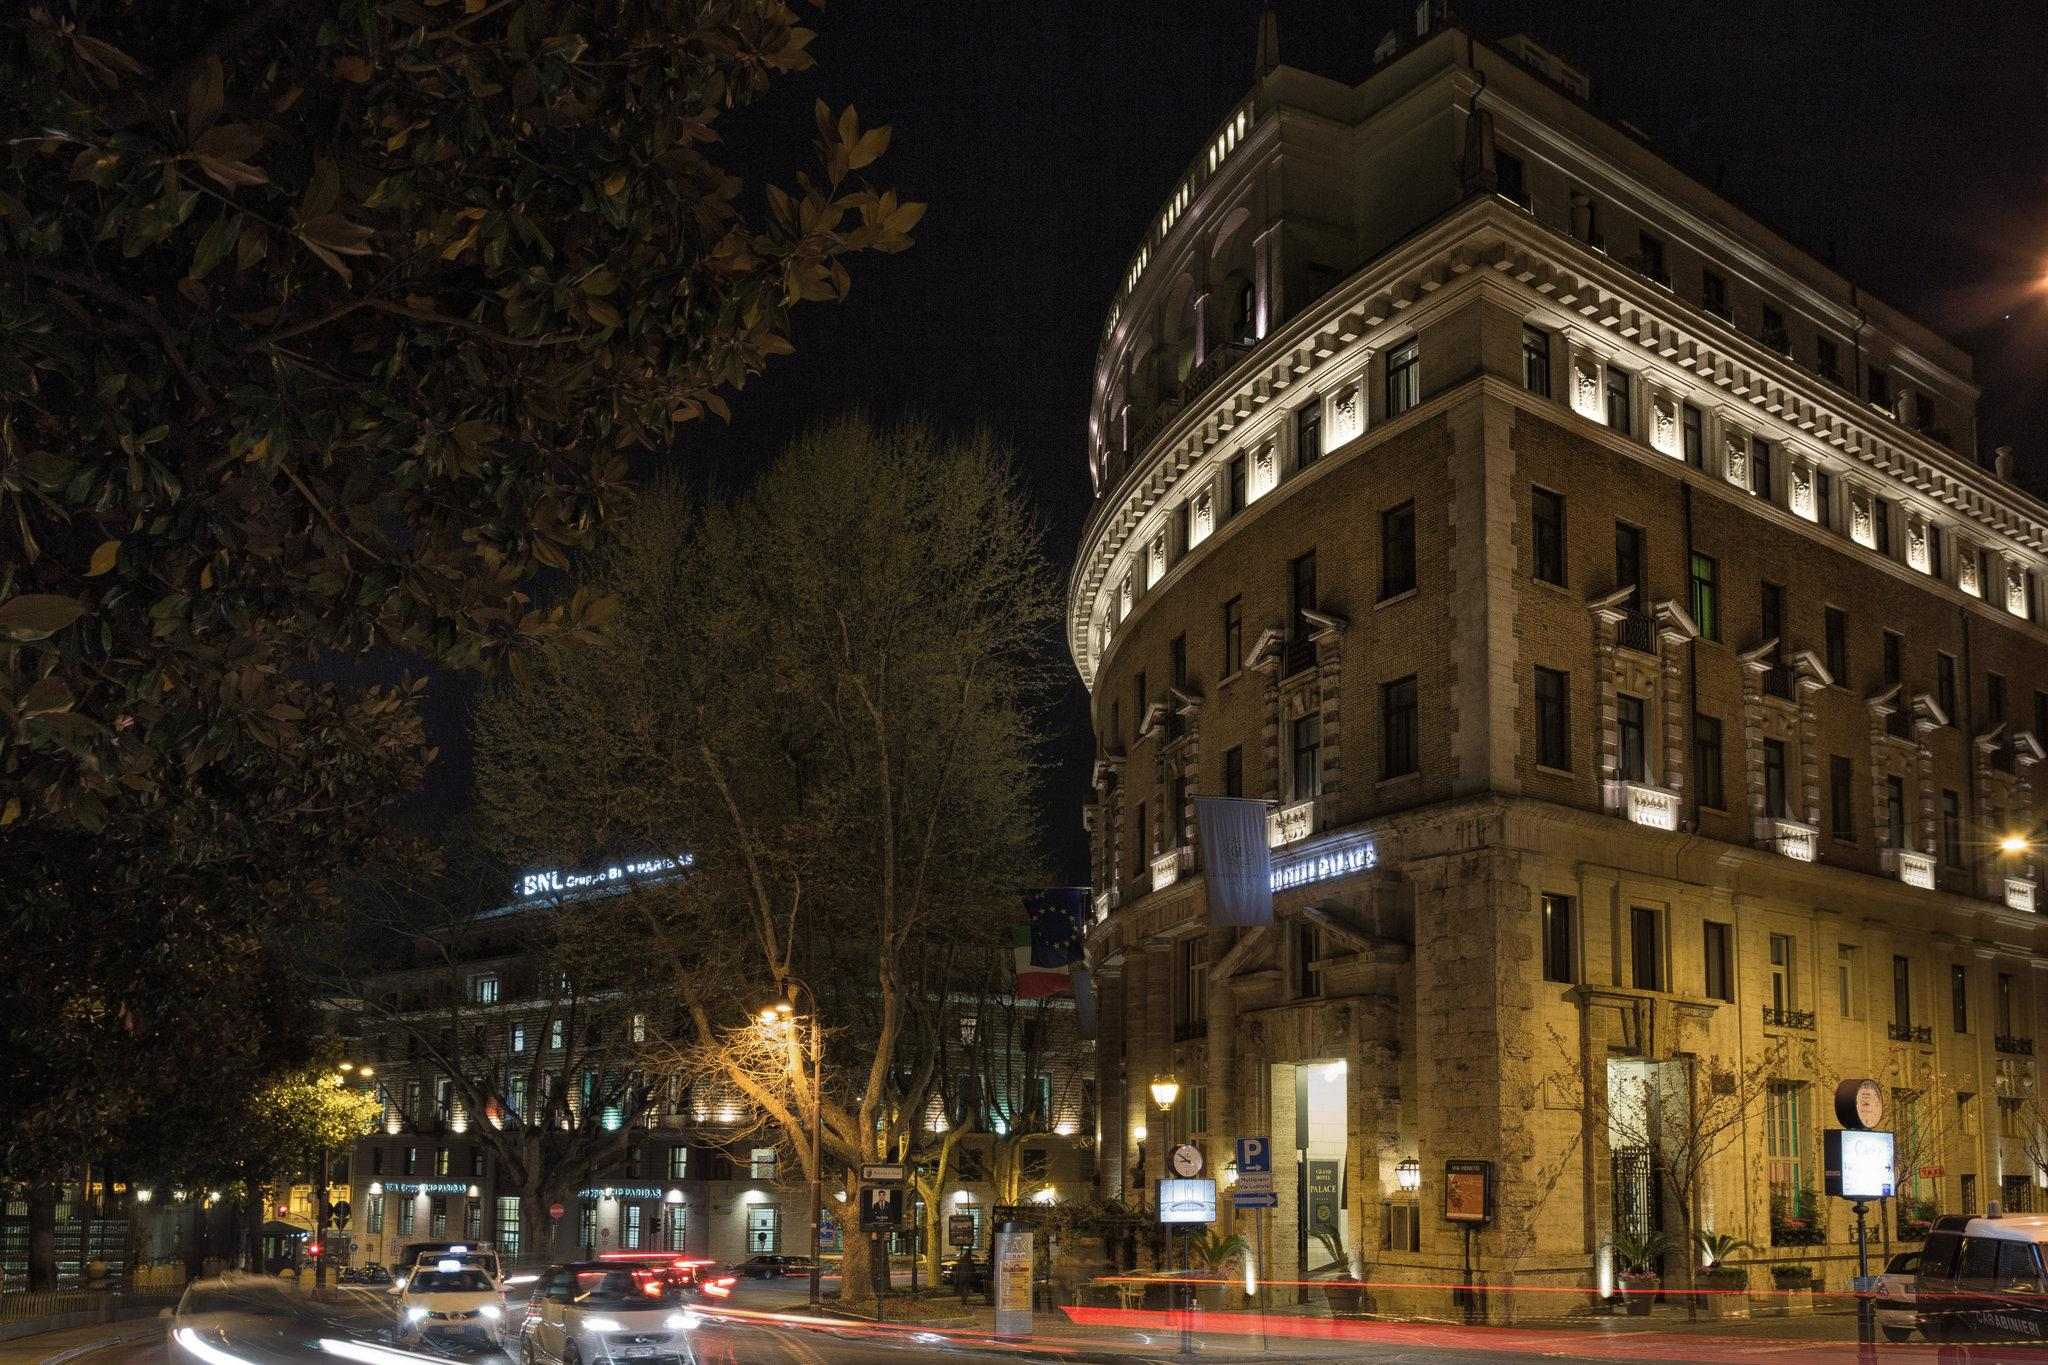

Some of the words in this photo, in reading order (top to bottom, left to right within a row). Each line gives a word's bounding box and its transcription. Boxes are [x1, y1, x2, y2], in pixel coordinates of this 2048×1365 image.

[1318, 841, 1376, 878] PALACE
[524, 871, 563, 896] BNL
[1245, 1140, 1261, 1164] P
[1310, 1185, 1337, 1193] PALACE
[1976, 1311, 2041, 1337] CARABINIERI
